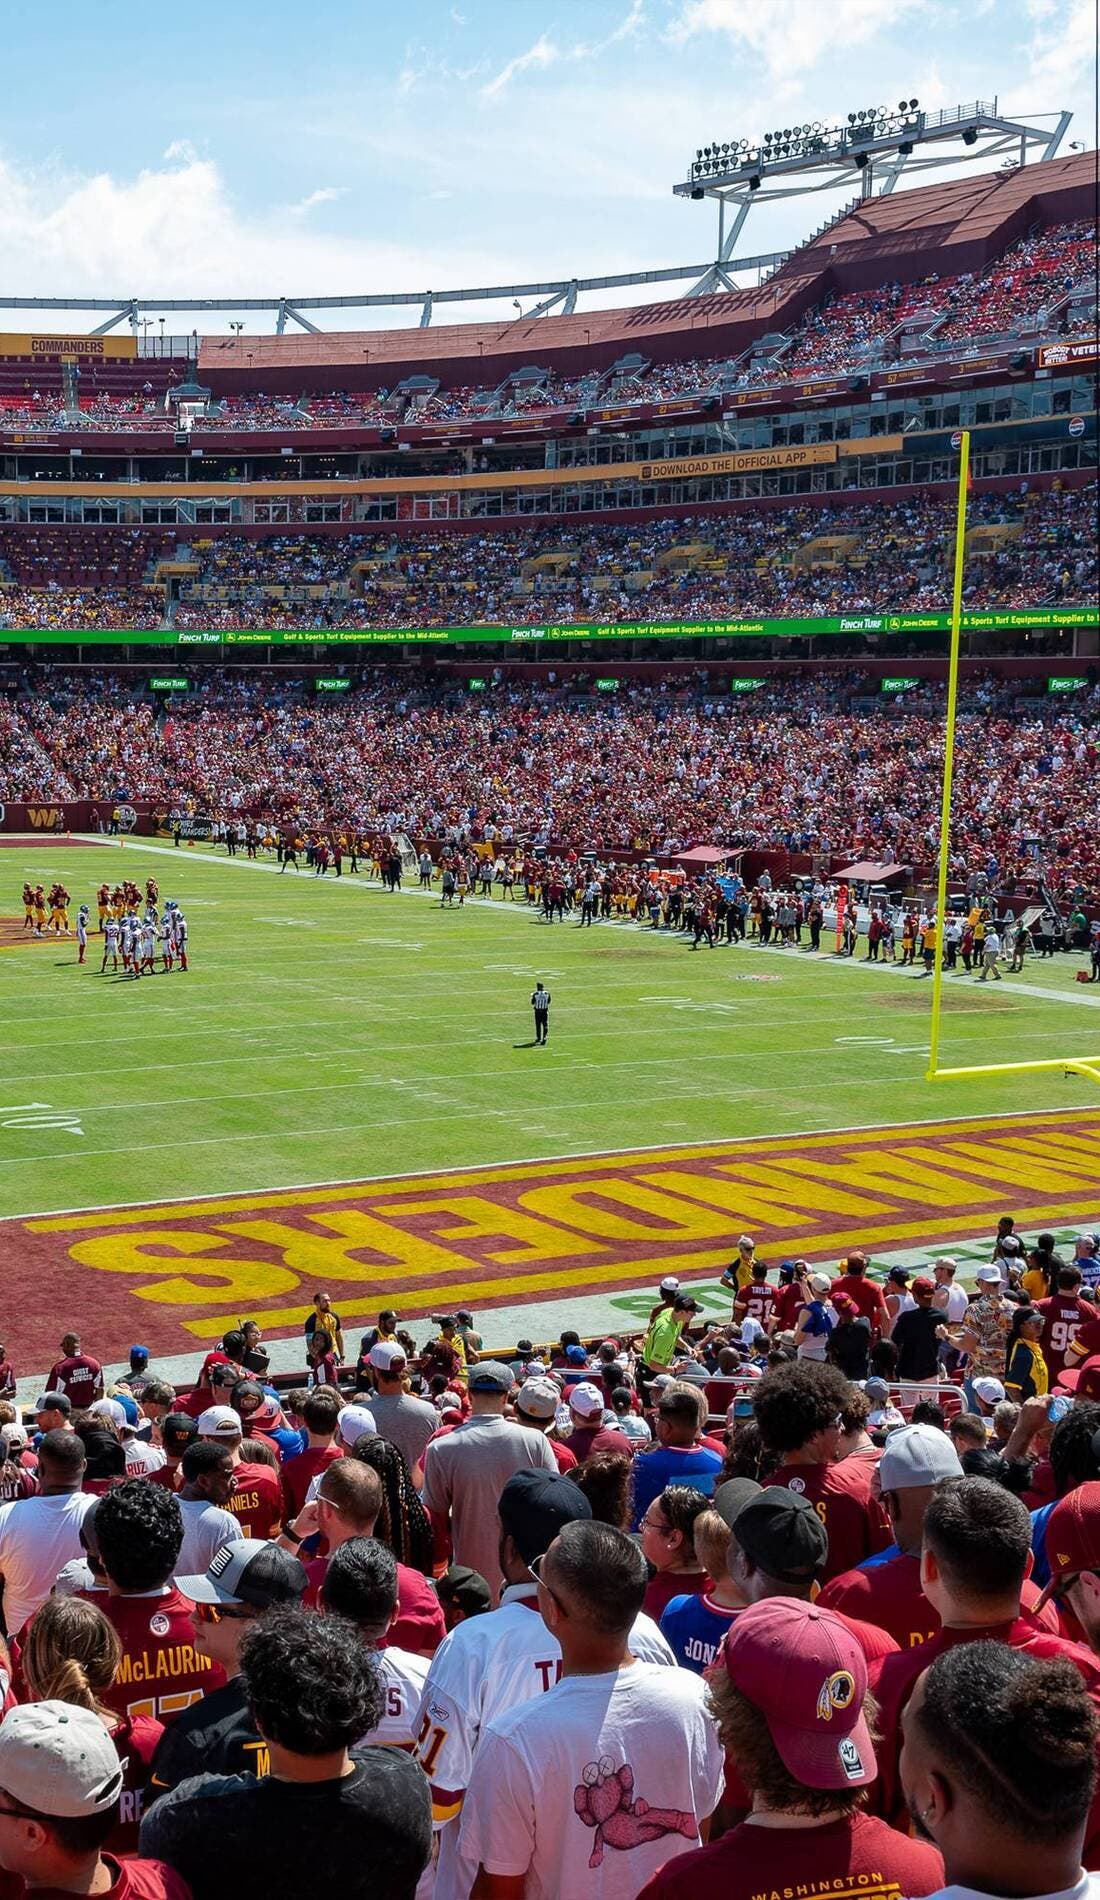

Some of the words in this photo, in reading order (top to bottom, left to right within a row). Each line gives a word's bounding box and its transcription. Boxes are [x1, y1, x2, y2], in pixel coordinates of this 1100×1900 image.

[31, 340, 104, 353] COMMANDERS
[653, 463, 709, 476] DOWNLOAD
[711, 459, 731, 471] THE
[737, 456, 782, 469] OFFICIAL
[785, 451, 807, 463] APP
[840, 619, 863, 629] FINCH
[864, 618, 882, 628] TURF
[918, 619, 938, 627] DEERE
[971, 617, 992, 626] Sports
[995, 616, 1009, 624] Turf
[1011, 615, 1050, 625] Equipment
[1053, 614, 1084, 624] Supplier
[597, 627, 610, 635] Golf
[617, 627, 636, 635] Sports
[637, 626, 648, 634] Turf
[650, 626, 680, 634] Equipment
[681, 625, 705, 634] Supplier
[178, 633, 202, 641] FINCH
[203, 633, 220, 641] TURF
[305, 633, 324, 641] Sports
[340, 633, 372, 641] Equipment
[373, 633, 397, 641] Supplier
[216, 1491, 260, 1512] ANIELS
[684, 1637, 717, 1666] JON
[115, 1645, 213, 1685] McLAURIN
[752, 1872, 883, 1900] WASHINGTON
